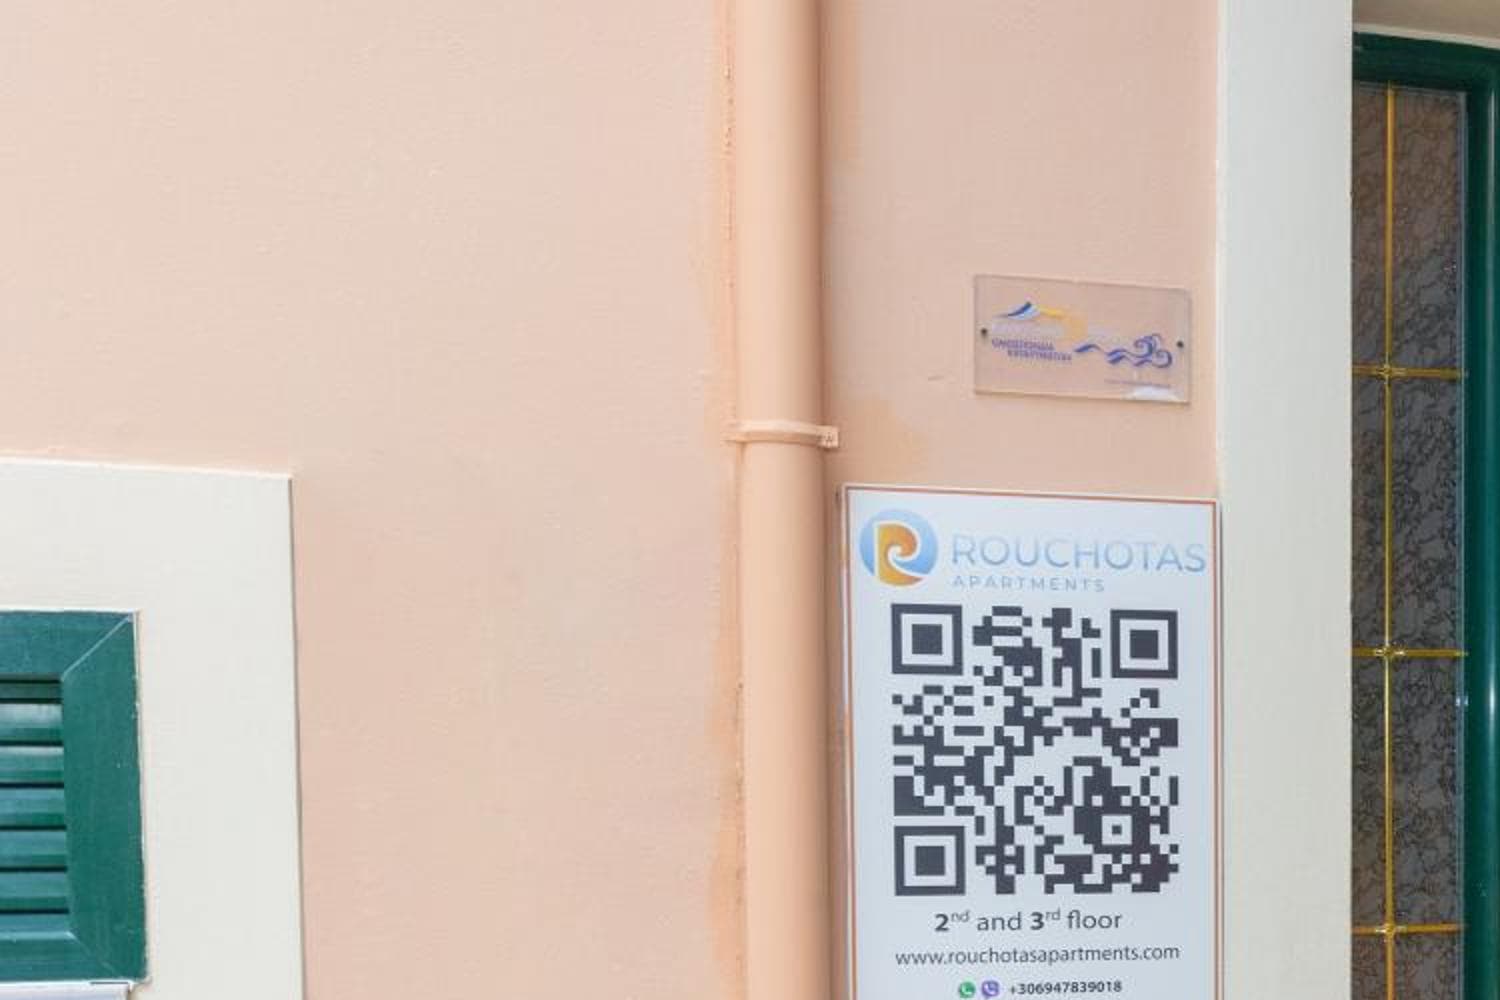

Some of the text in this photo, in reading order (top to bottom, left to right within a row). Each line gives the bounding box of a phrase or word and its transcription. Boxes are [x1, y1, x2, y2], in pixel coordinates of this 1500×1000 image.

[951, 533, 1207, 574] ROUCHOTAS
[952, 575, 1105, 593] APARTMENTS
[976, 912, 1022, 932] and
[1067, 909, 1122, 930] floor
[895, 944, 1180, 967] www.rouchotasapartments.com
[1008, 980, 1122, 996] +306947839018
